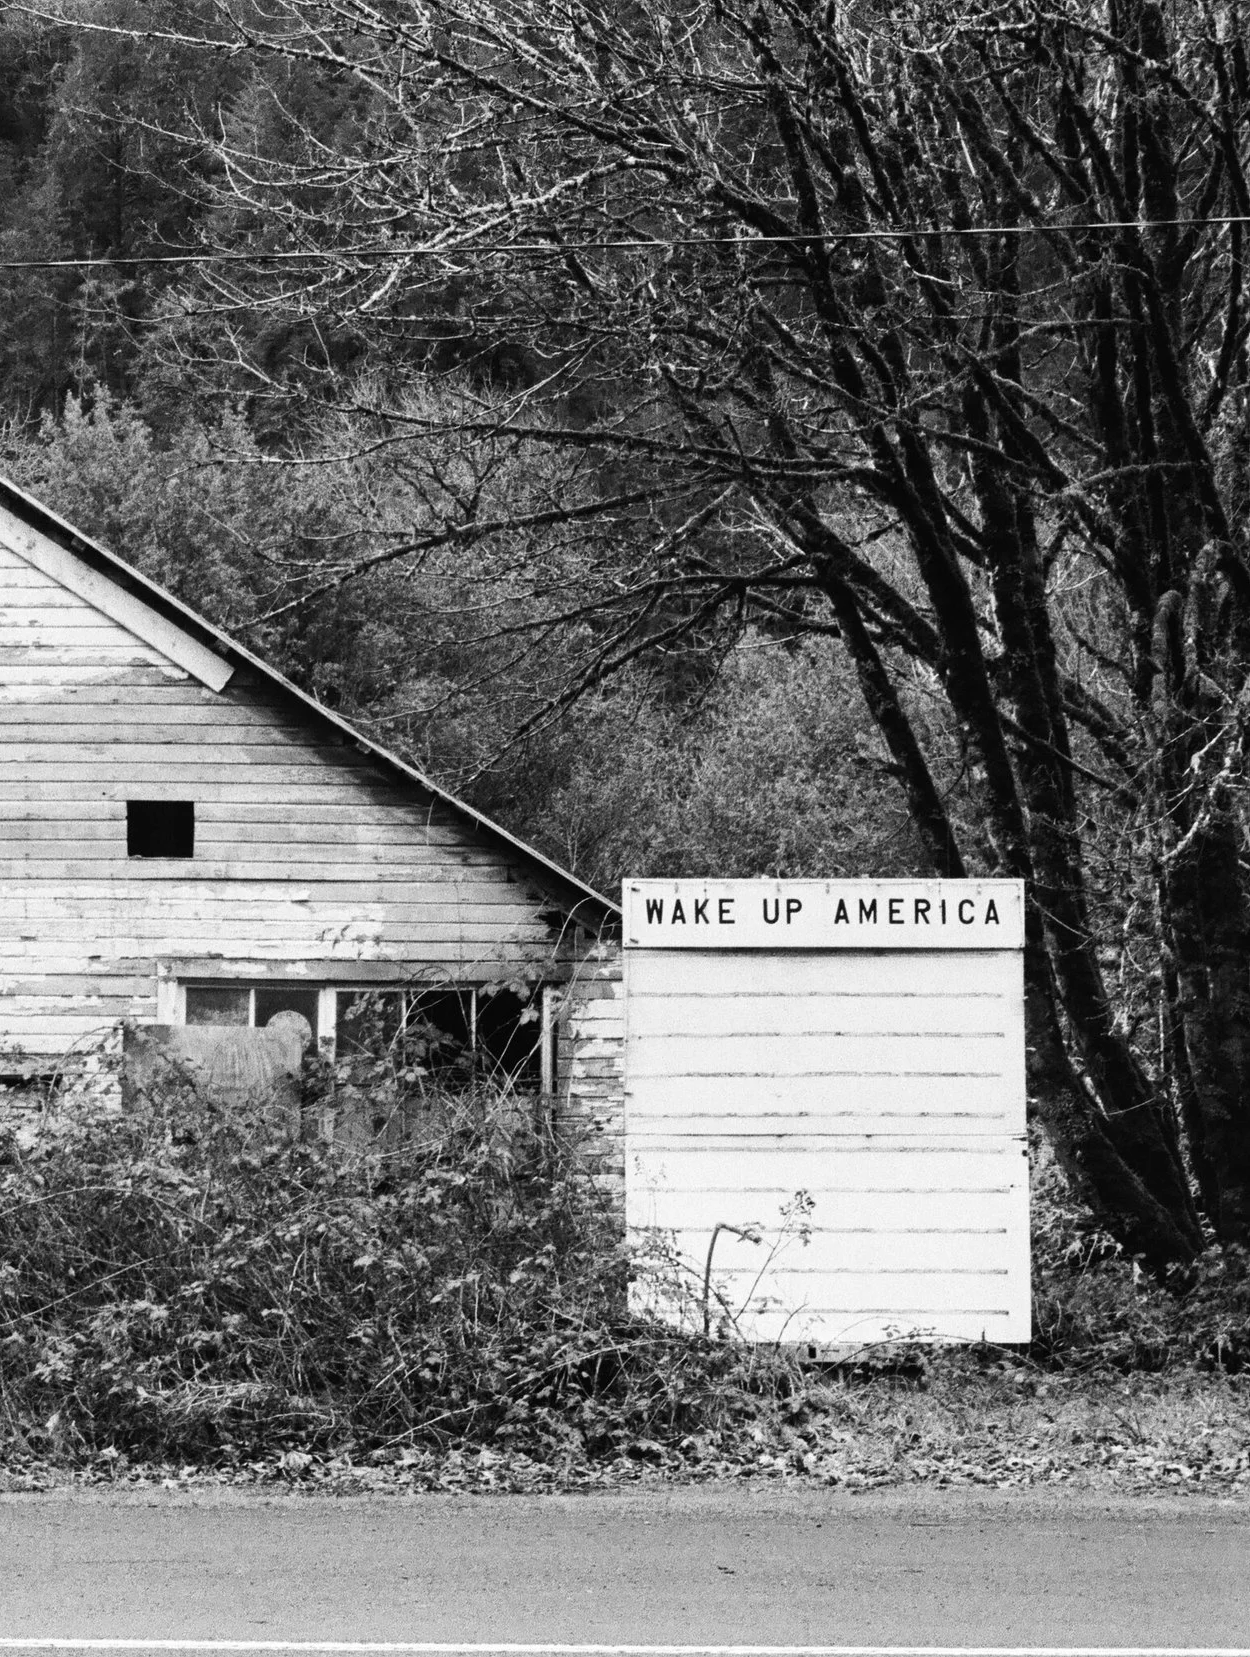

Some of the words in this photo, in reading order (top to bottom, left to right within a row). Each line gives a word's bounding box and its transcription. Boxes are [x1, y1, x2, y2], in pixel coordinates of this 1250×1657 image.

[646, 898, 735, 925] WAKE
[763, 898, 803, 925] UP
[834, 898, 1001, 925] AMERICA
